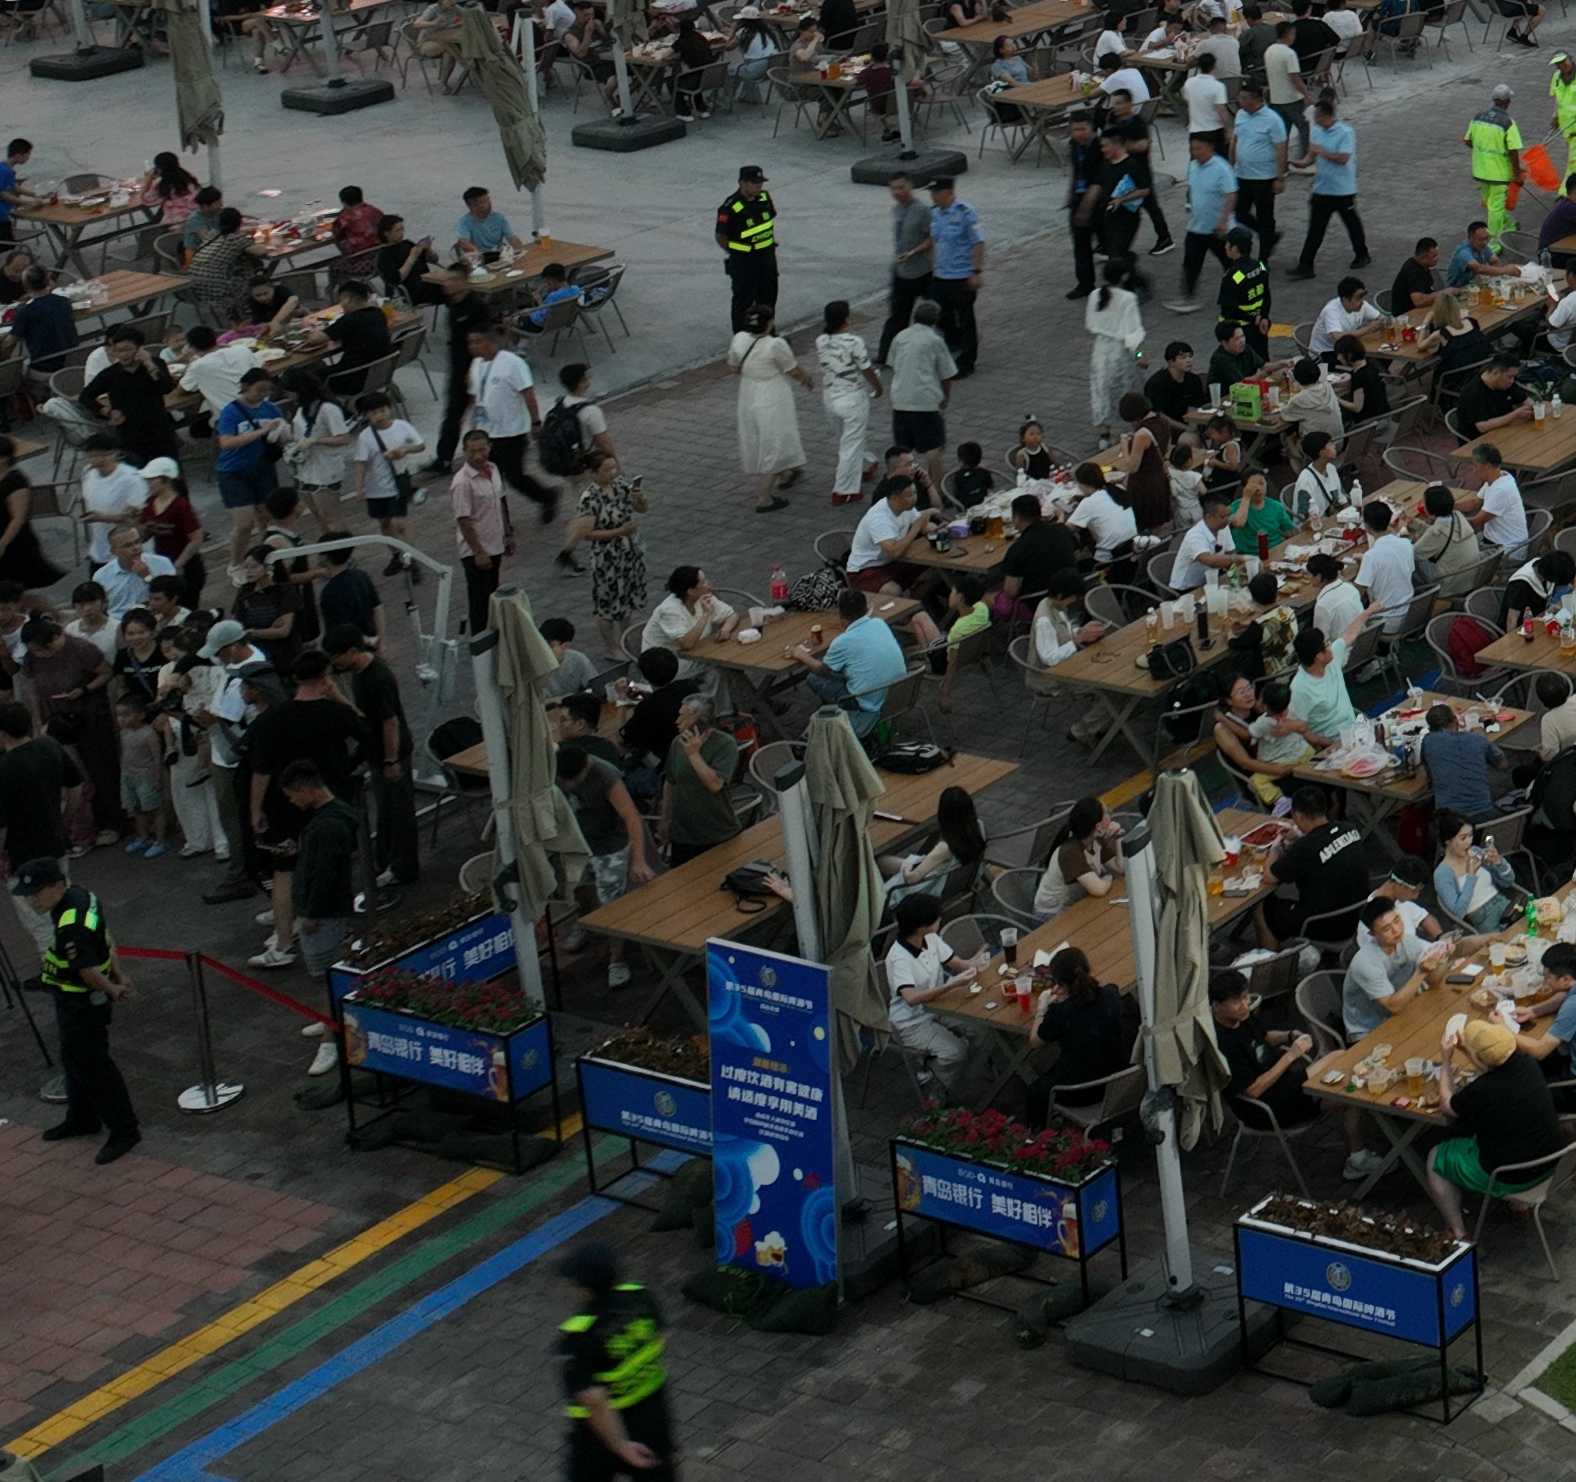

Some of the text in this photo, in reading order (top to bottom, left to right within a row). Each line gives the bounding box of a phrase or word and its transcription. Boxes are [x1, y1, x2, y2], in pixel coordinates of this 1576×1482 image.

[720, 1064, 824, 1103] 过度饮酒有害健康
[727, 1085, 818, 1121] 请适度享用美酒
[922, 1175, 1053, 1229] 青岛银行 美好相伴
[1283, 1282, 1397, 1321] 第35届青岛国际啤酒节
